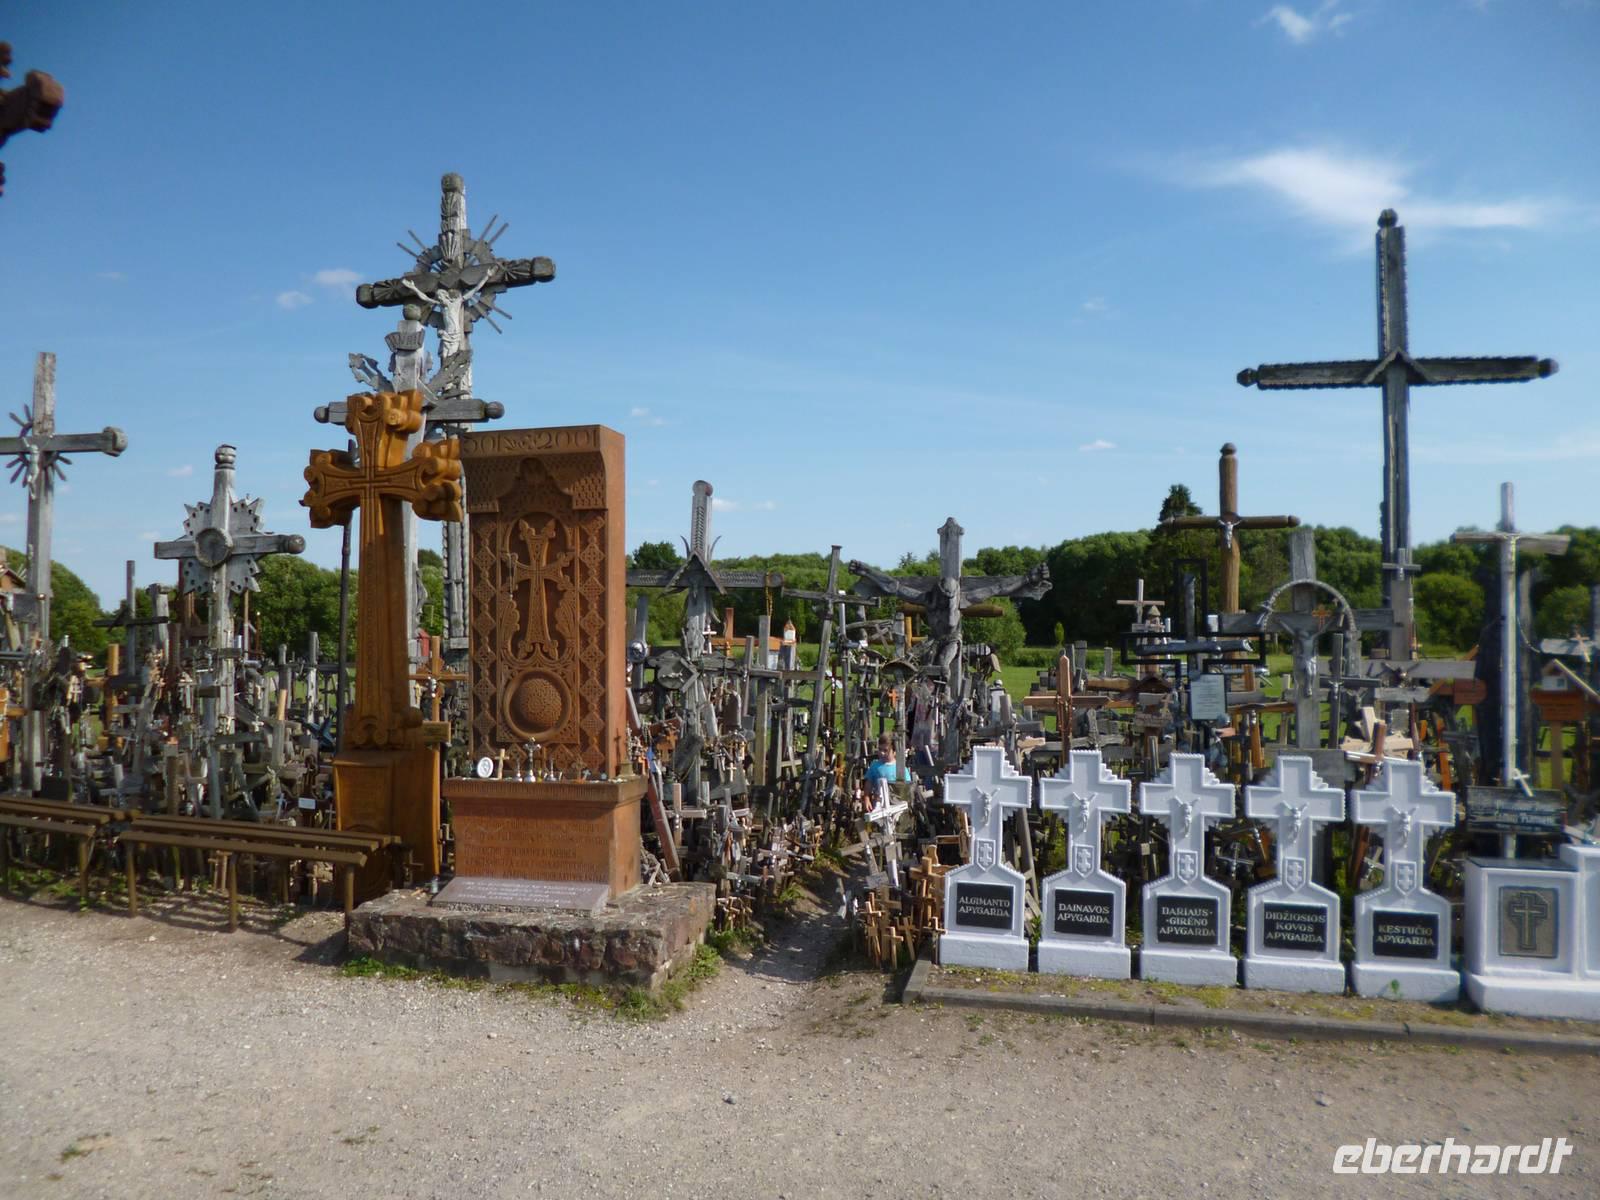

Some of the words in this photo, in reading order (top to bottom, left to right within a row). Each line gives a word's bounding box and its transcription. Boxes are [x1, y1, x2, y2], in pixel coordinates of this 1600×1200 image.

[958, 896, 1010, 908] ALGIMANTO
[958, 906, 1011, 917] APYGARDA
[1058, 903, 1110, 914] DAINAVOS
[1057, 914, 1110, 924] APYGARDA
[1159, 926, 1216, 937] APYGARDA
[1276, 922, 1314, 932] KOVOS
[1265, 931, 1325, 943] APYGARDA
[1376, 935, 1435, 945] APYGARDA
